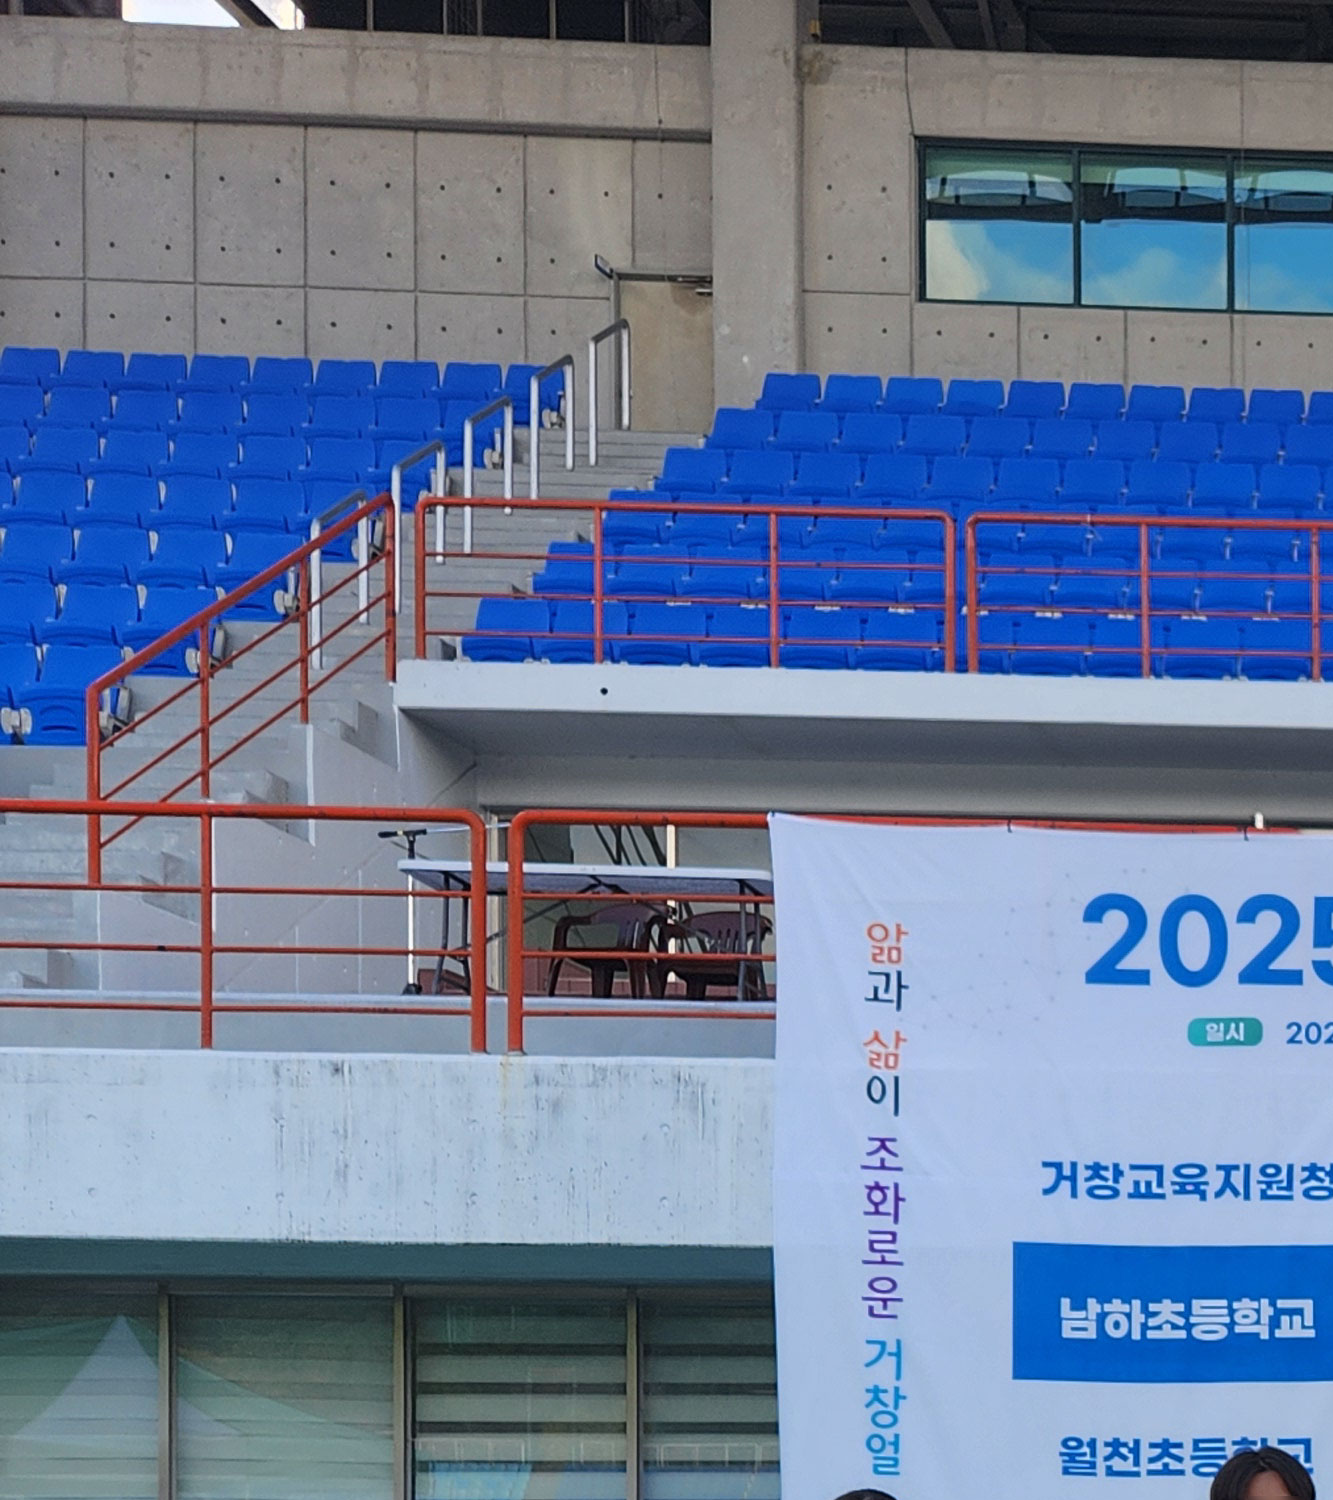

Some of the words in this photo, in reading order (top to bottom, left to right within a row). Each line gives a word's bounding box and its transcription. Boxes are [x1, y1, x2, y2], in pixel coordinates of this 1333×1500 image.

[865, 924, 909, 1011] 앎과
[1205, 1018, 1246, 1043] 일시
[866, 1032, 905, 1116] 삶이
[861, 1138, 905, 1319] 조화로운
[1061, 1298, 1315, 1340] 남하초등학교
[865, 1339, 907, 1475] 거창얼
